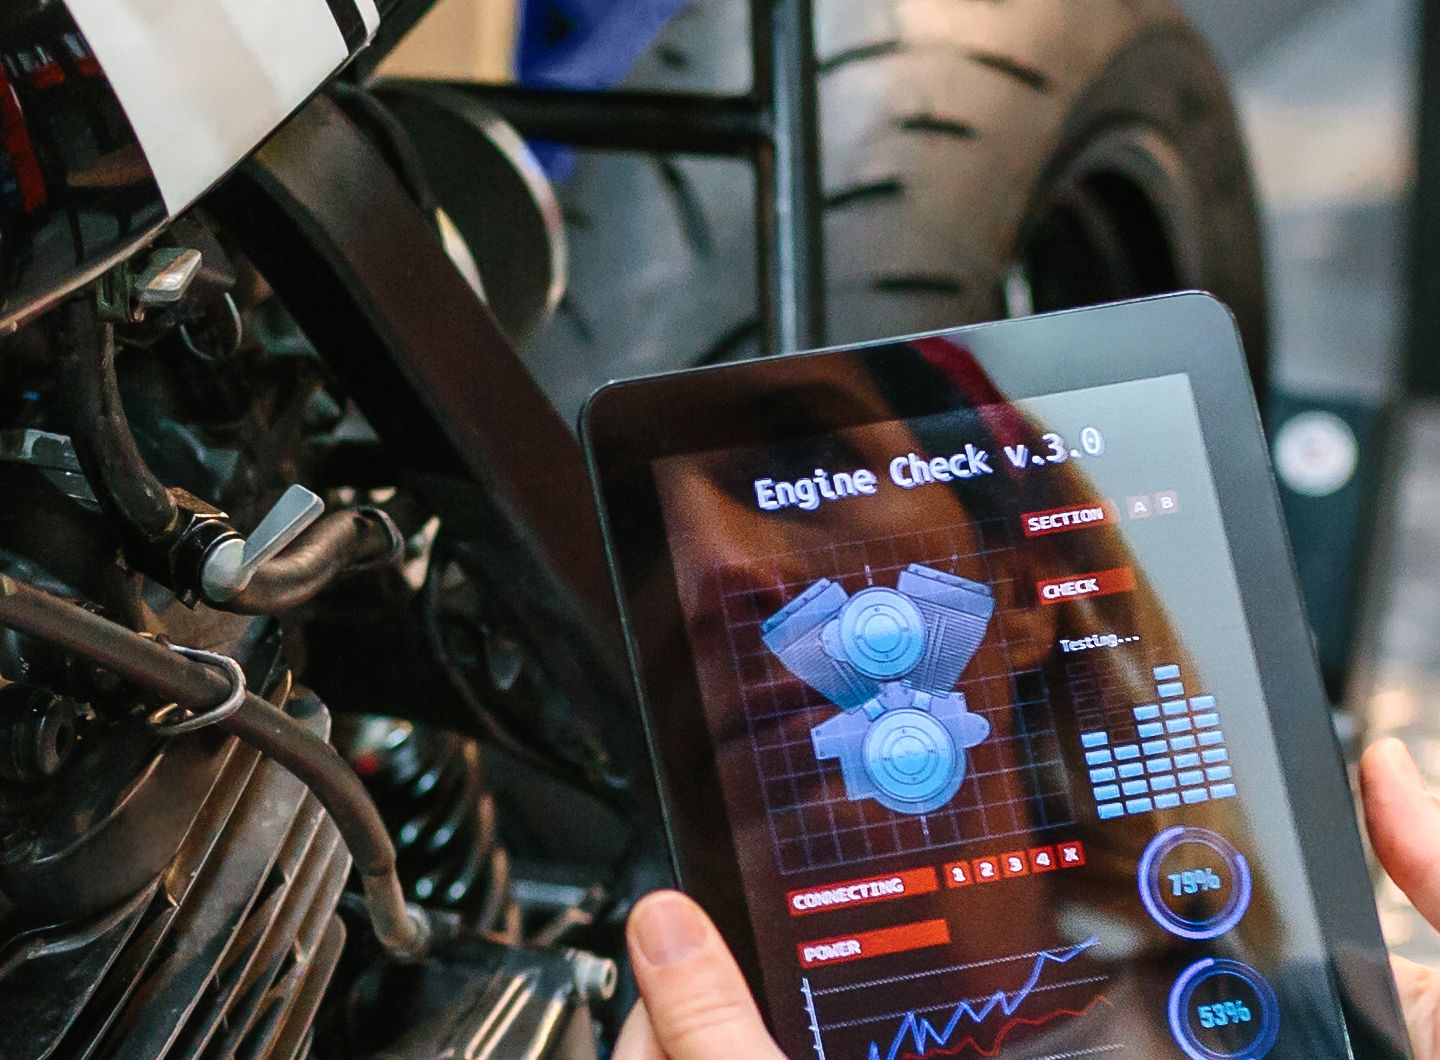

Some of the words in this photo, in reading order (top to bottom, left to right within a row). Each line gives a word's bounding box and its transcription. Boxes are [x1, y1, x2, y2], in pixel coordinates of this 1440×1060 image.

[754, 468, 878, 511] Engine
[889, 443, 993, 488] Check
[1004, 426, 1105, 468] v.3.0
[1027, 507, 1104, 531] SECTION
[1134, 501, 1147, 513] A
[1160, 496, 1173, 508] B
[1042, 578, 1099, 598] CHECK
[1060, 634, 1139, 652] Testing...
[793, 878, 904, 909] CONNECTING
[952, 867, 966, 882] 1
[979, 861, 994, 877] 2
[1008, 857, 1022, 872] 3
[1035, 852, 1051, 866] 4
[1062, 847, 1079, 861] X
[803, 940, 861, 962] POWER
[1198, 1000, 1251, 1028] 53%
